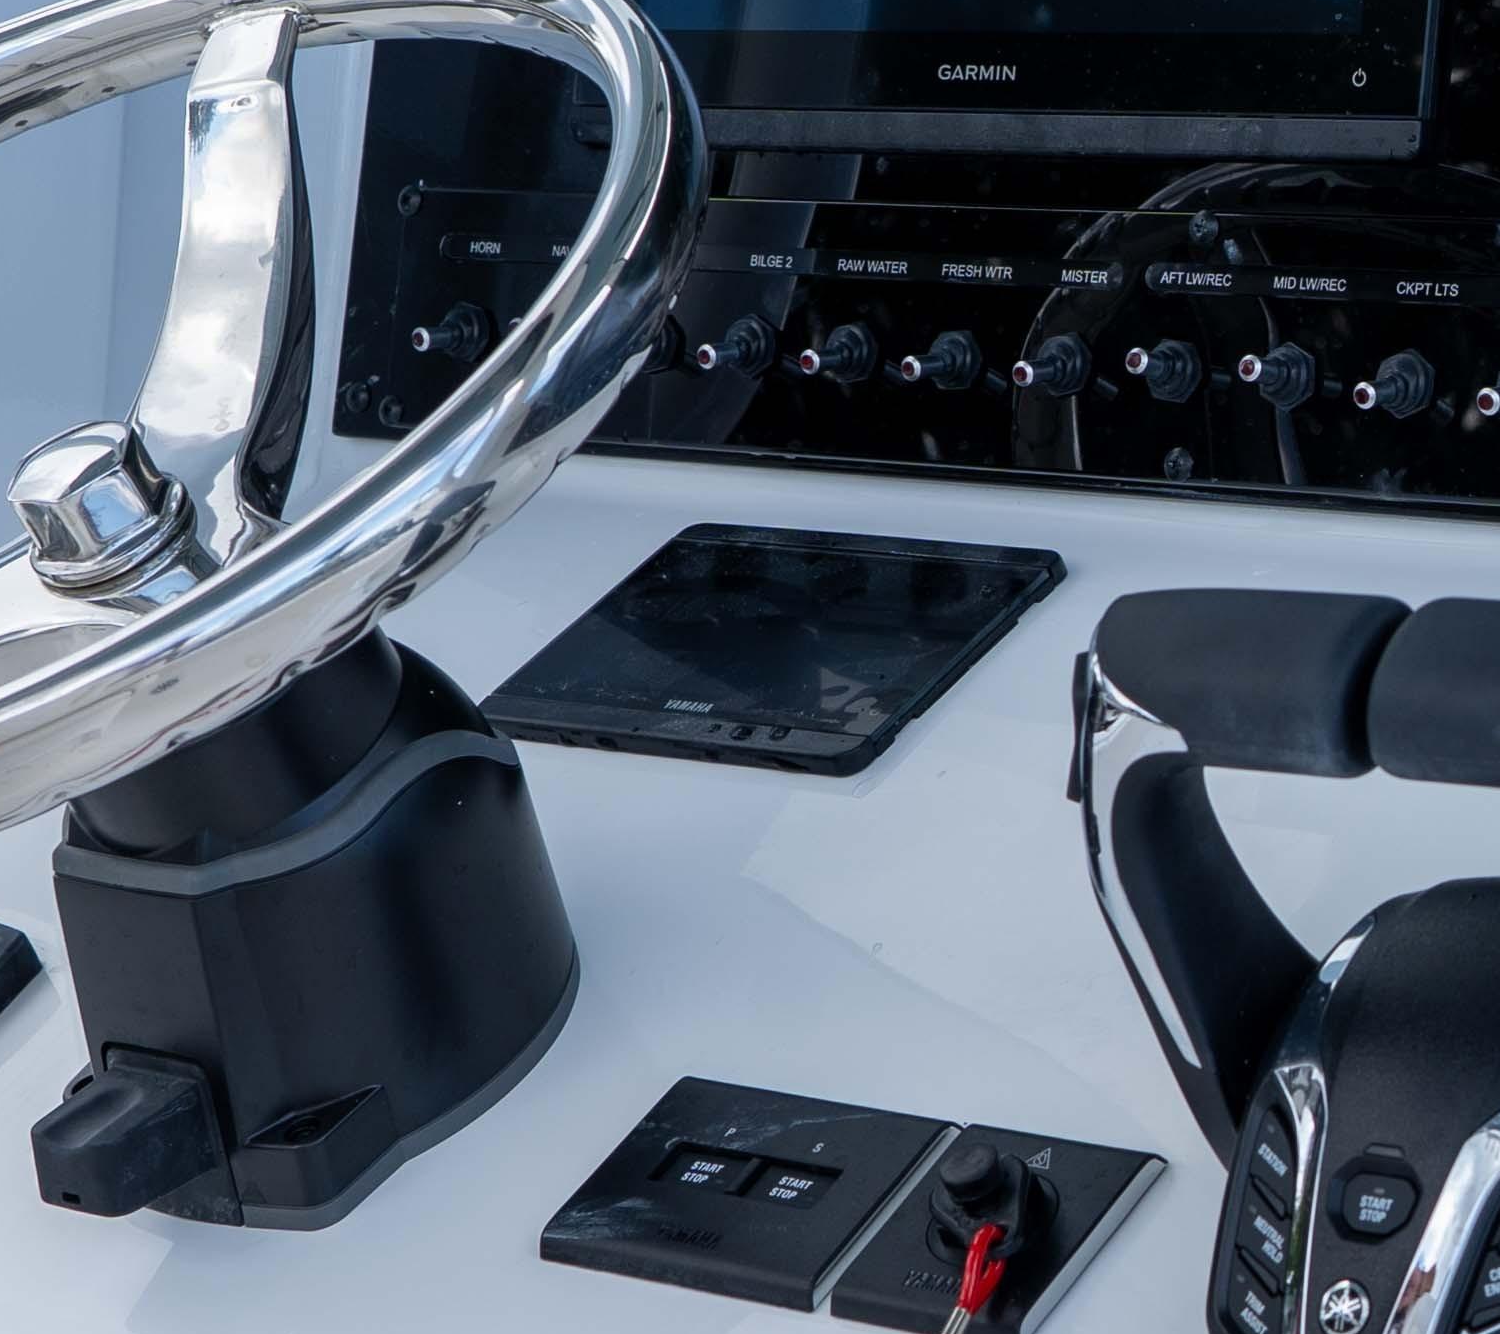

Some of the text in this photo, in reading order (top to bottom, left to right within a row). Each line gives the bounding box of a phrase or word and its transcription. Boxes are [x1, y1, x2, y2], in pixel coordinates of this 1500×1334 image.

[936, 63, 1018, 82] GARMIN
[470, 241, 501, 254] HORN
[750, 254, 793, 269] BILGE 2
[838, 259, 907, 275] RAW WATER
[941, 264, 1012, 280] FRESH WTR
[1061, 269, 1108, 285] MISTER
[1160, 272, 1232, 288] AFT LW/REC
[1273, 276, 1347, 293] MID LW/REC
[1396, 281, 1459, 298] CKPT LTS
[662, 699, 715, 714] YAMAHA
[690, 1161, 725, 1174] START
[681, 1172, 709, 1184] STOP
